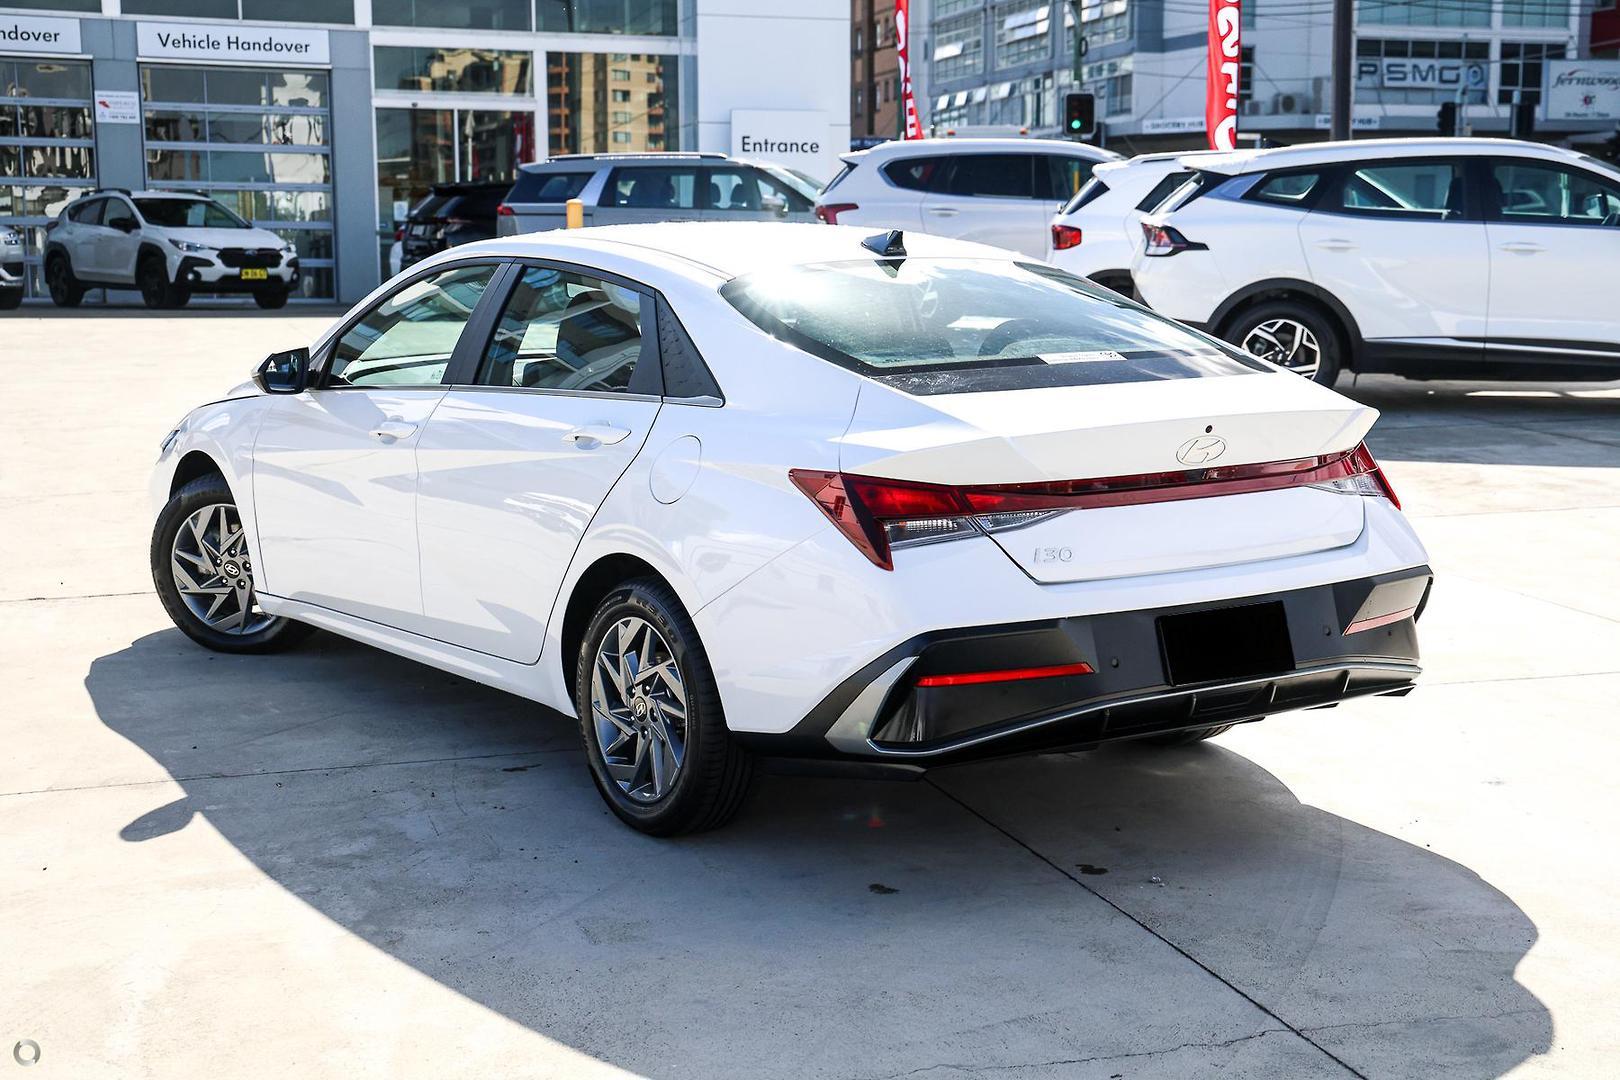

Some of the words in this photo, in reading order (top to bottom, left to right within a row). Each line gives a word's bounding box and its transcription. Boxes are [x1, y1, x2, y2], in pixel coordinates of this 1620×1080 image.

[157, 32, 221, 51] Vehicle
[226, 35, 310, 54] Handover
[741, 135, 820, 154] Entrance
